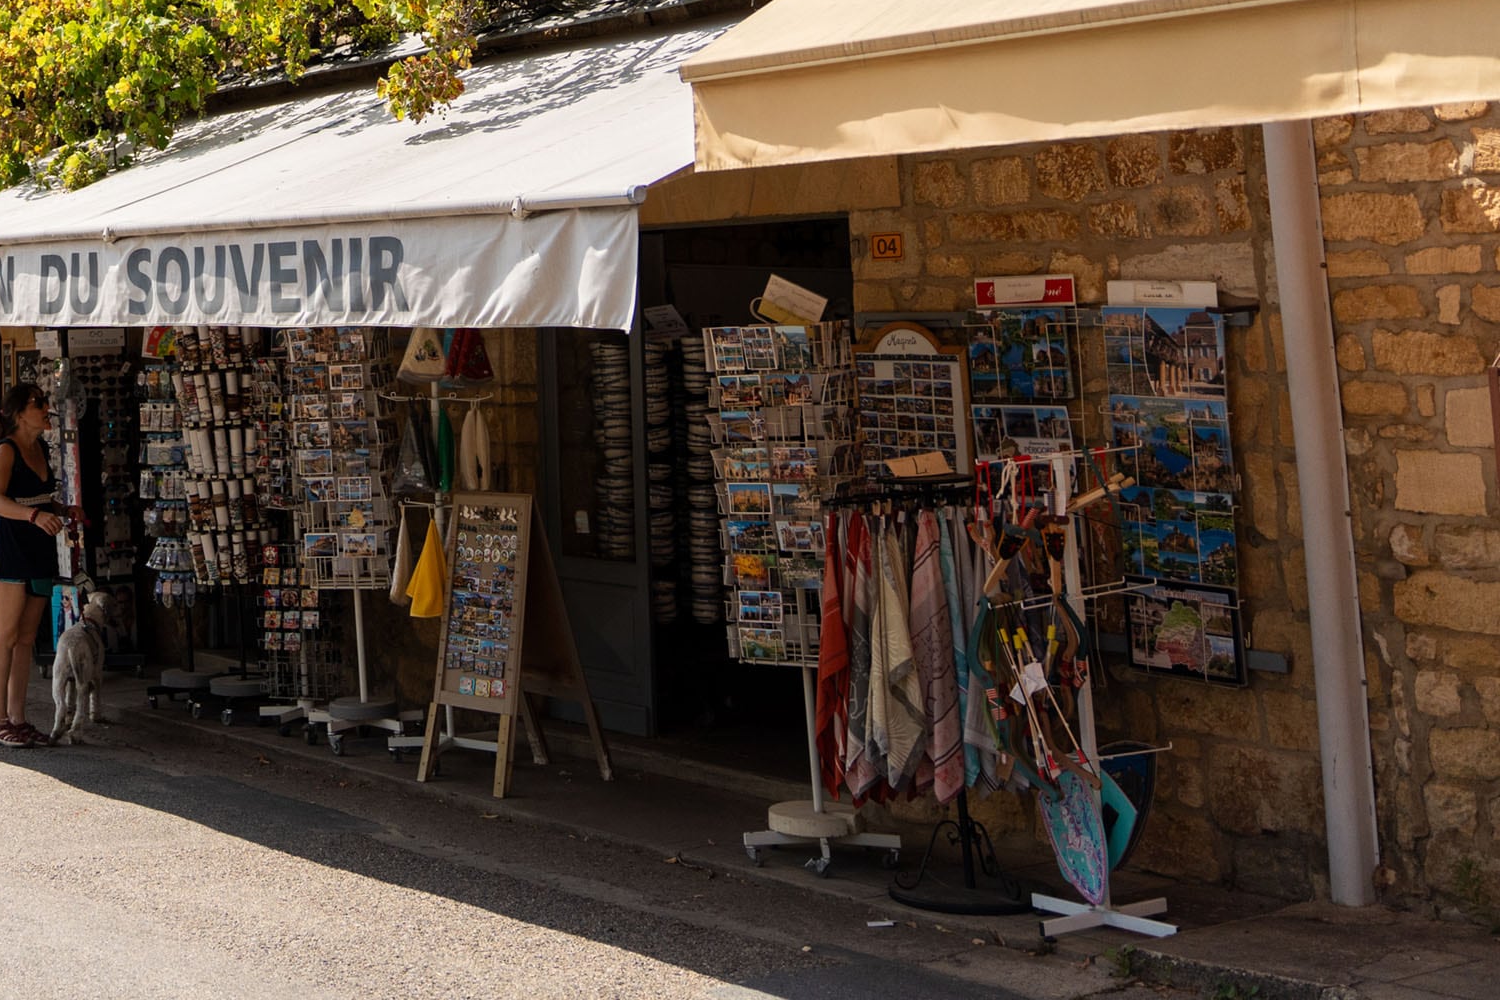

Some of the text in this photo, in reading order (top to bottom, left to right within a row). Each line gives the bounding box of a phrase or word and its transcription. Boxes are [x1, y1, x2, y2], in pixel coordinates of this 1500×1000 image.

[876, 238, 898, 255] 04
[38, 251, 99, 316] DU
[126, 235, 411, 316] SOUVENIR
